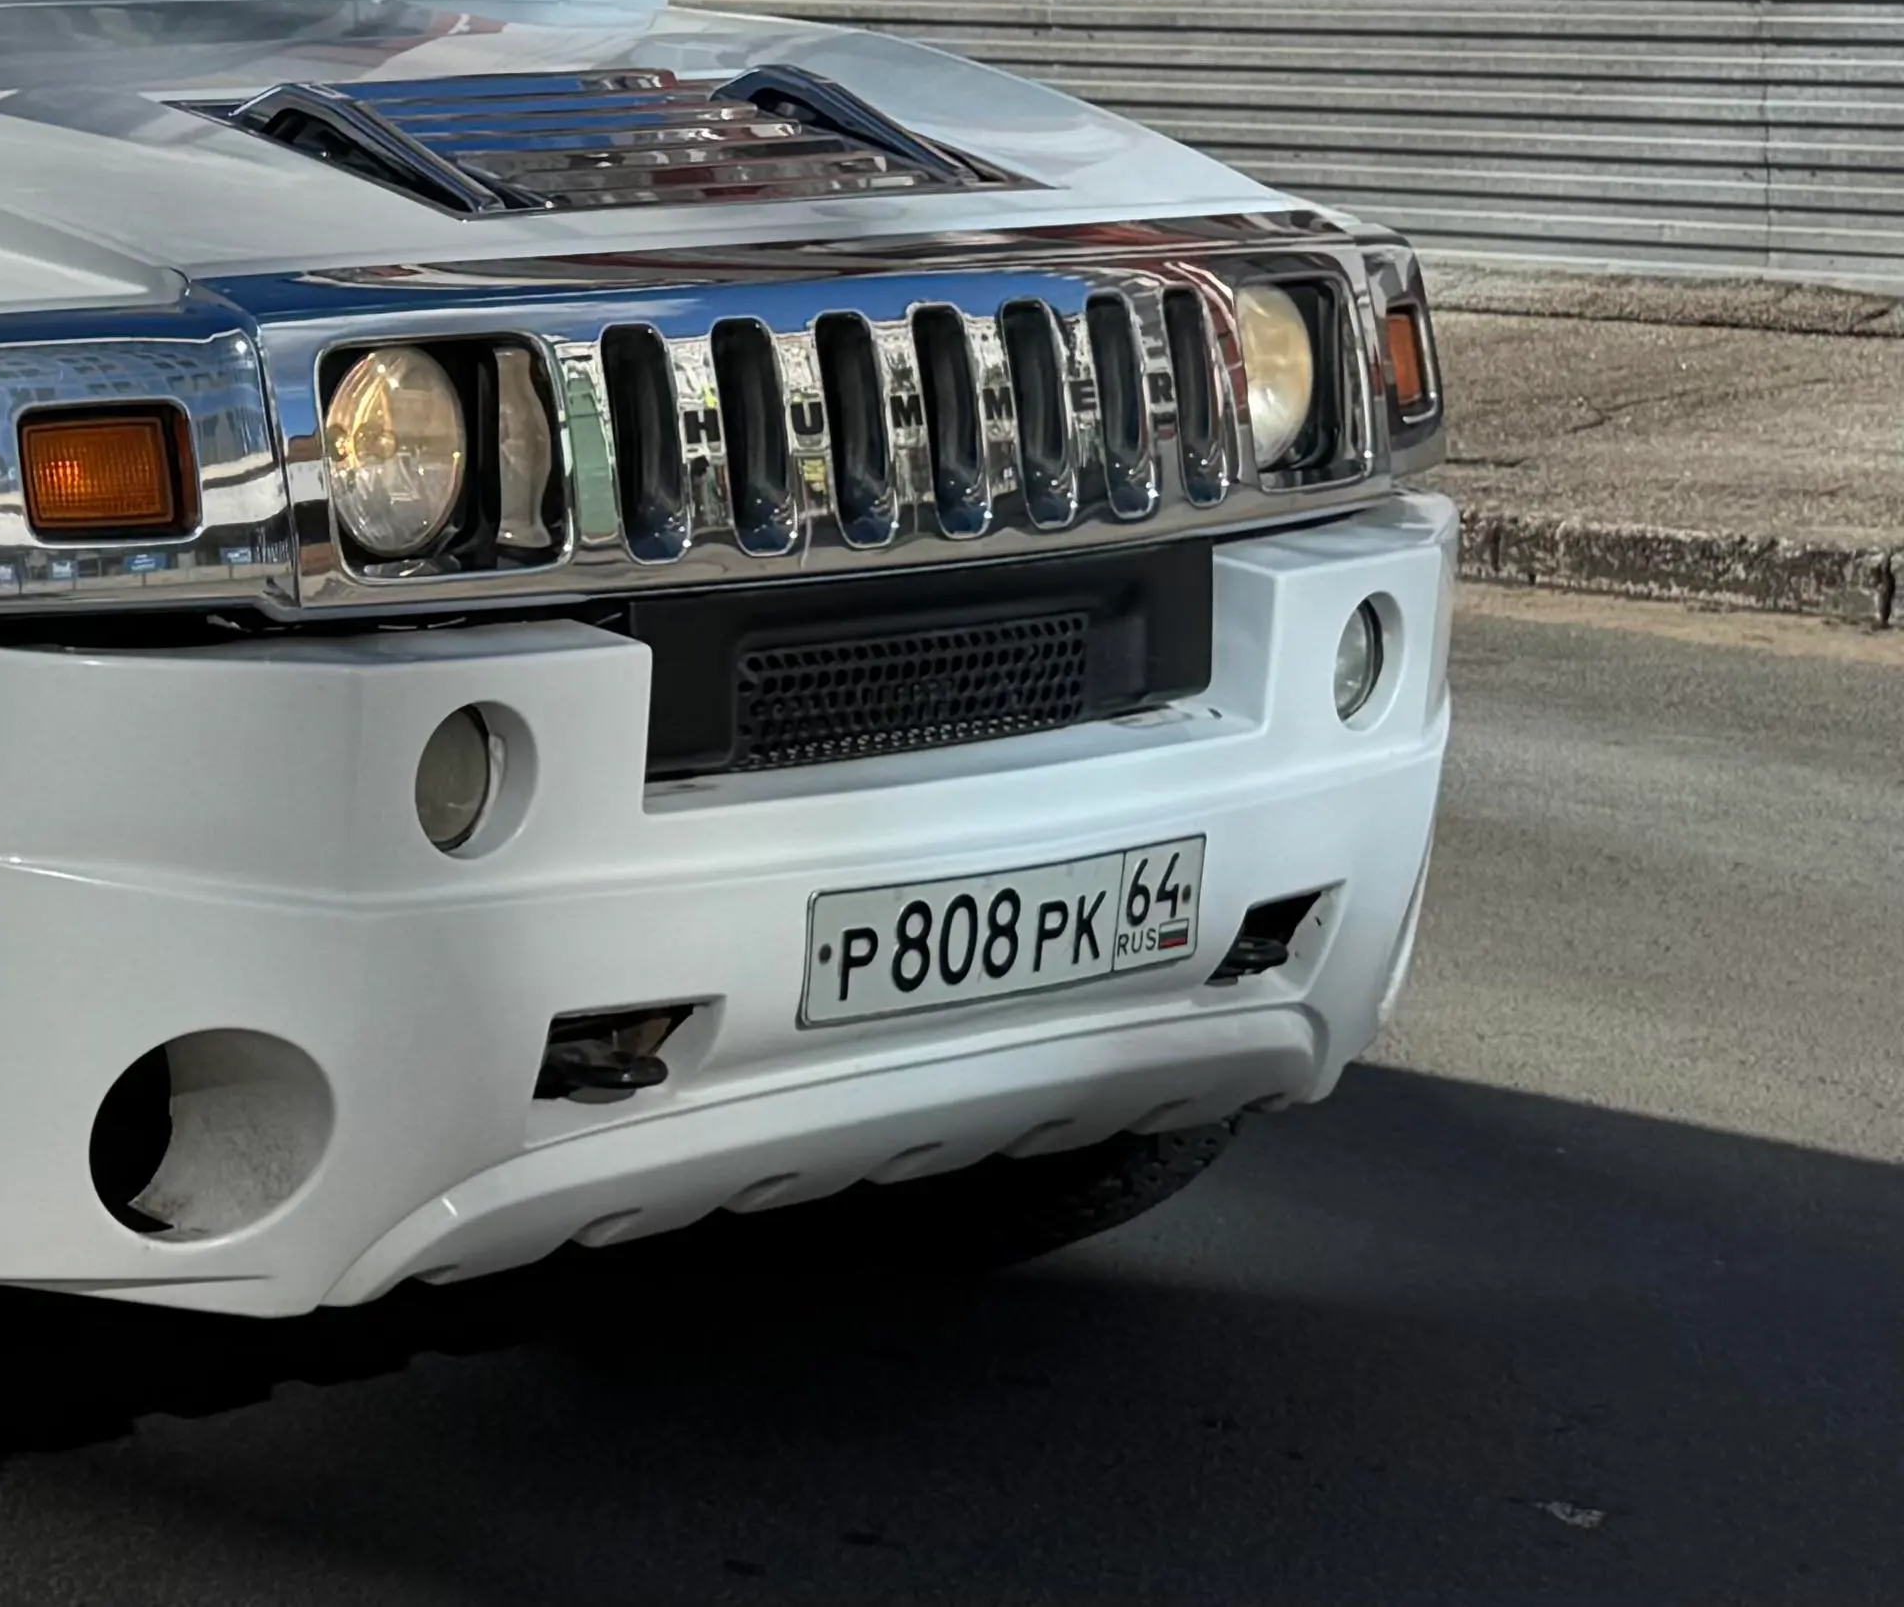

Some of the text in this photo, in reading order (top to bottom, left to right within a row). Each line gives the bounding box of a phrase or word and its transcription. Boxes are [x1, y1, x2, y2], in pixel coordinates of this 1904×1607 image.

[683, 371, 1173, 444] HUMMER
[1125, 852, 1181, 927] 64
[1117, 933, 1157, 958] RUS
